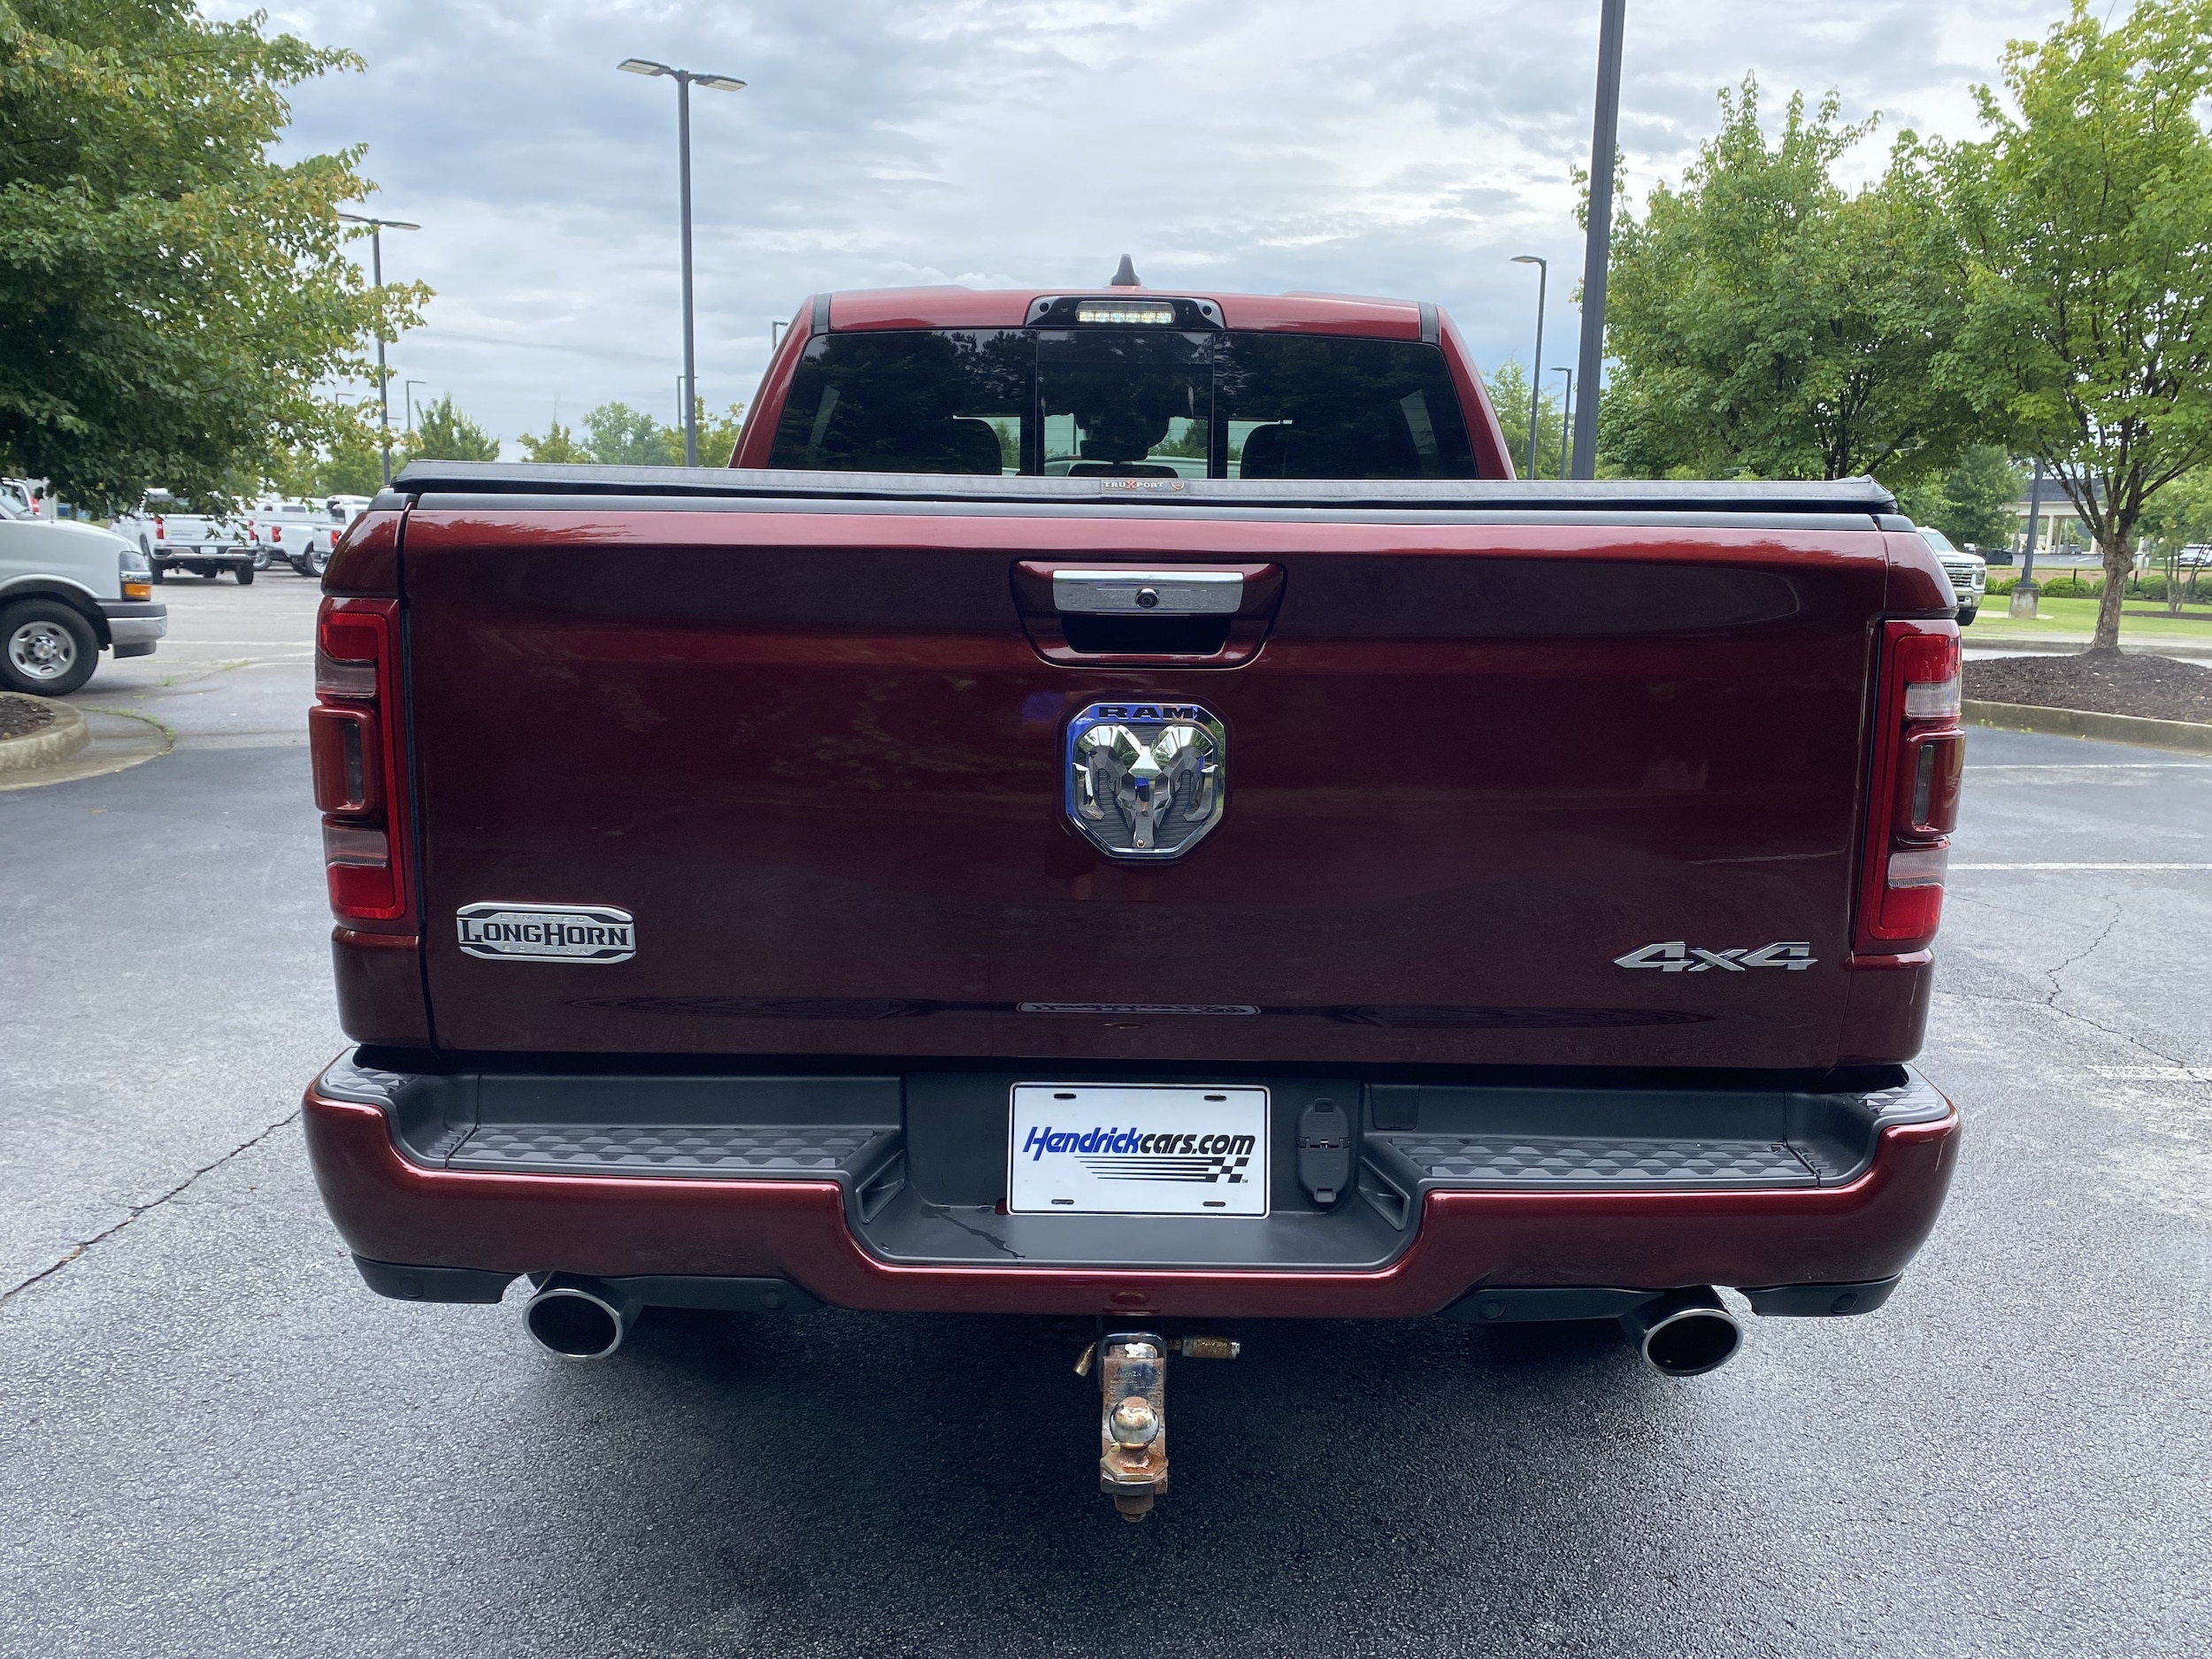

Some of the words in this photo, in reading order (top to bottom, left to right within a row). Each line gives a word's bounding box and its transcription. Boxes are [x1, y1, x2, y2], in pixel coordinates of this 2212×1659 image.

[1103, 480, 1164, 489] TRUXPORT
[1098, 707, 1196, 720] RAM
[499, 913, 586, 924] LIMITED
[459, 919, 630, 946] LONGHORN
[503, 945, 588, 956] EDITION
[1613, 941, 1819, 972] 4x4
[1022, 1125, 1256, 1162] Hendrickcars.com
